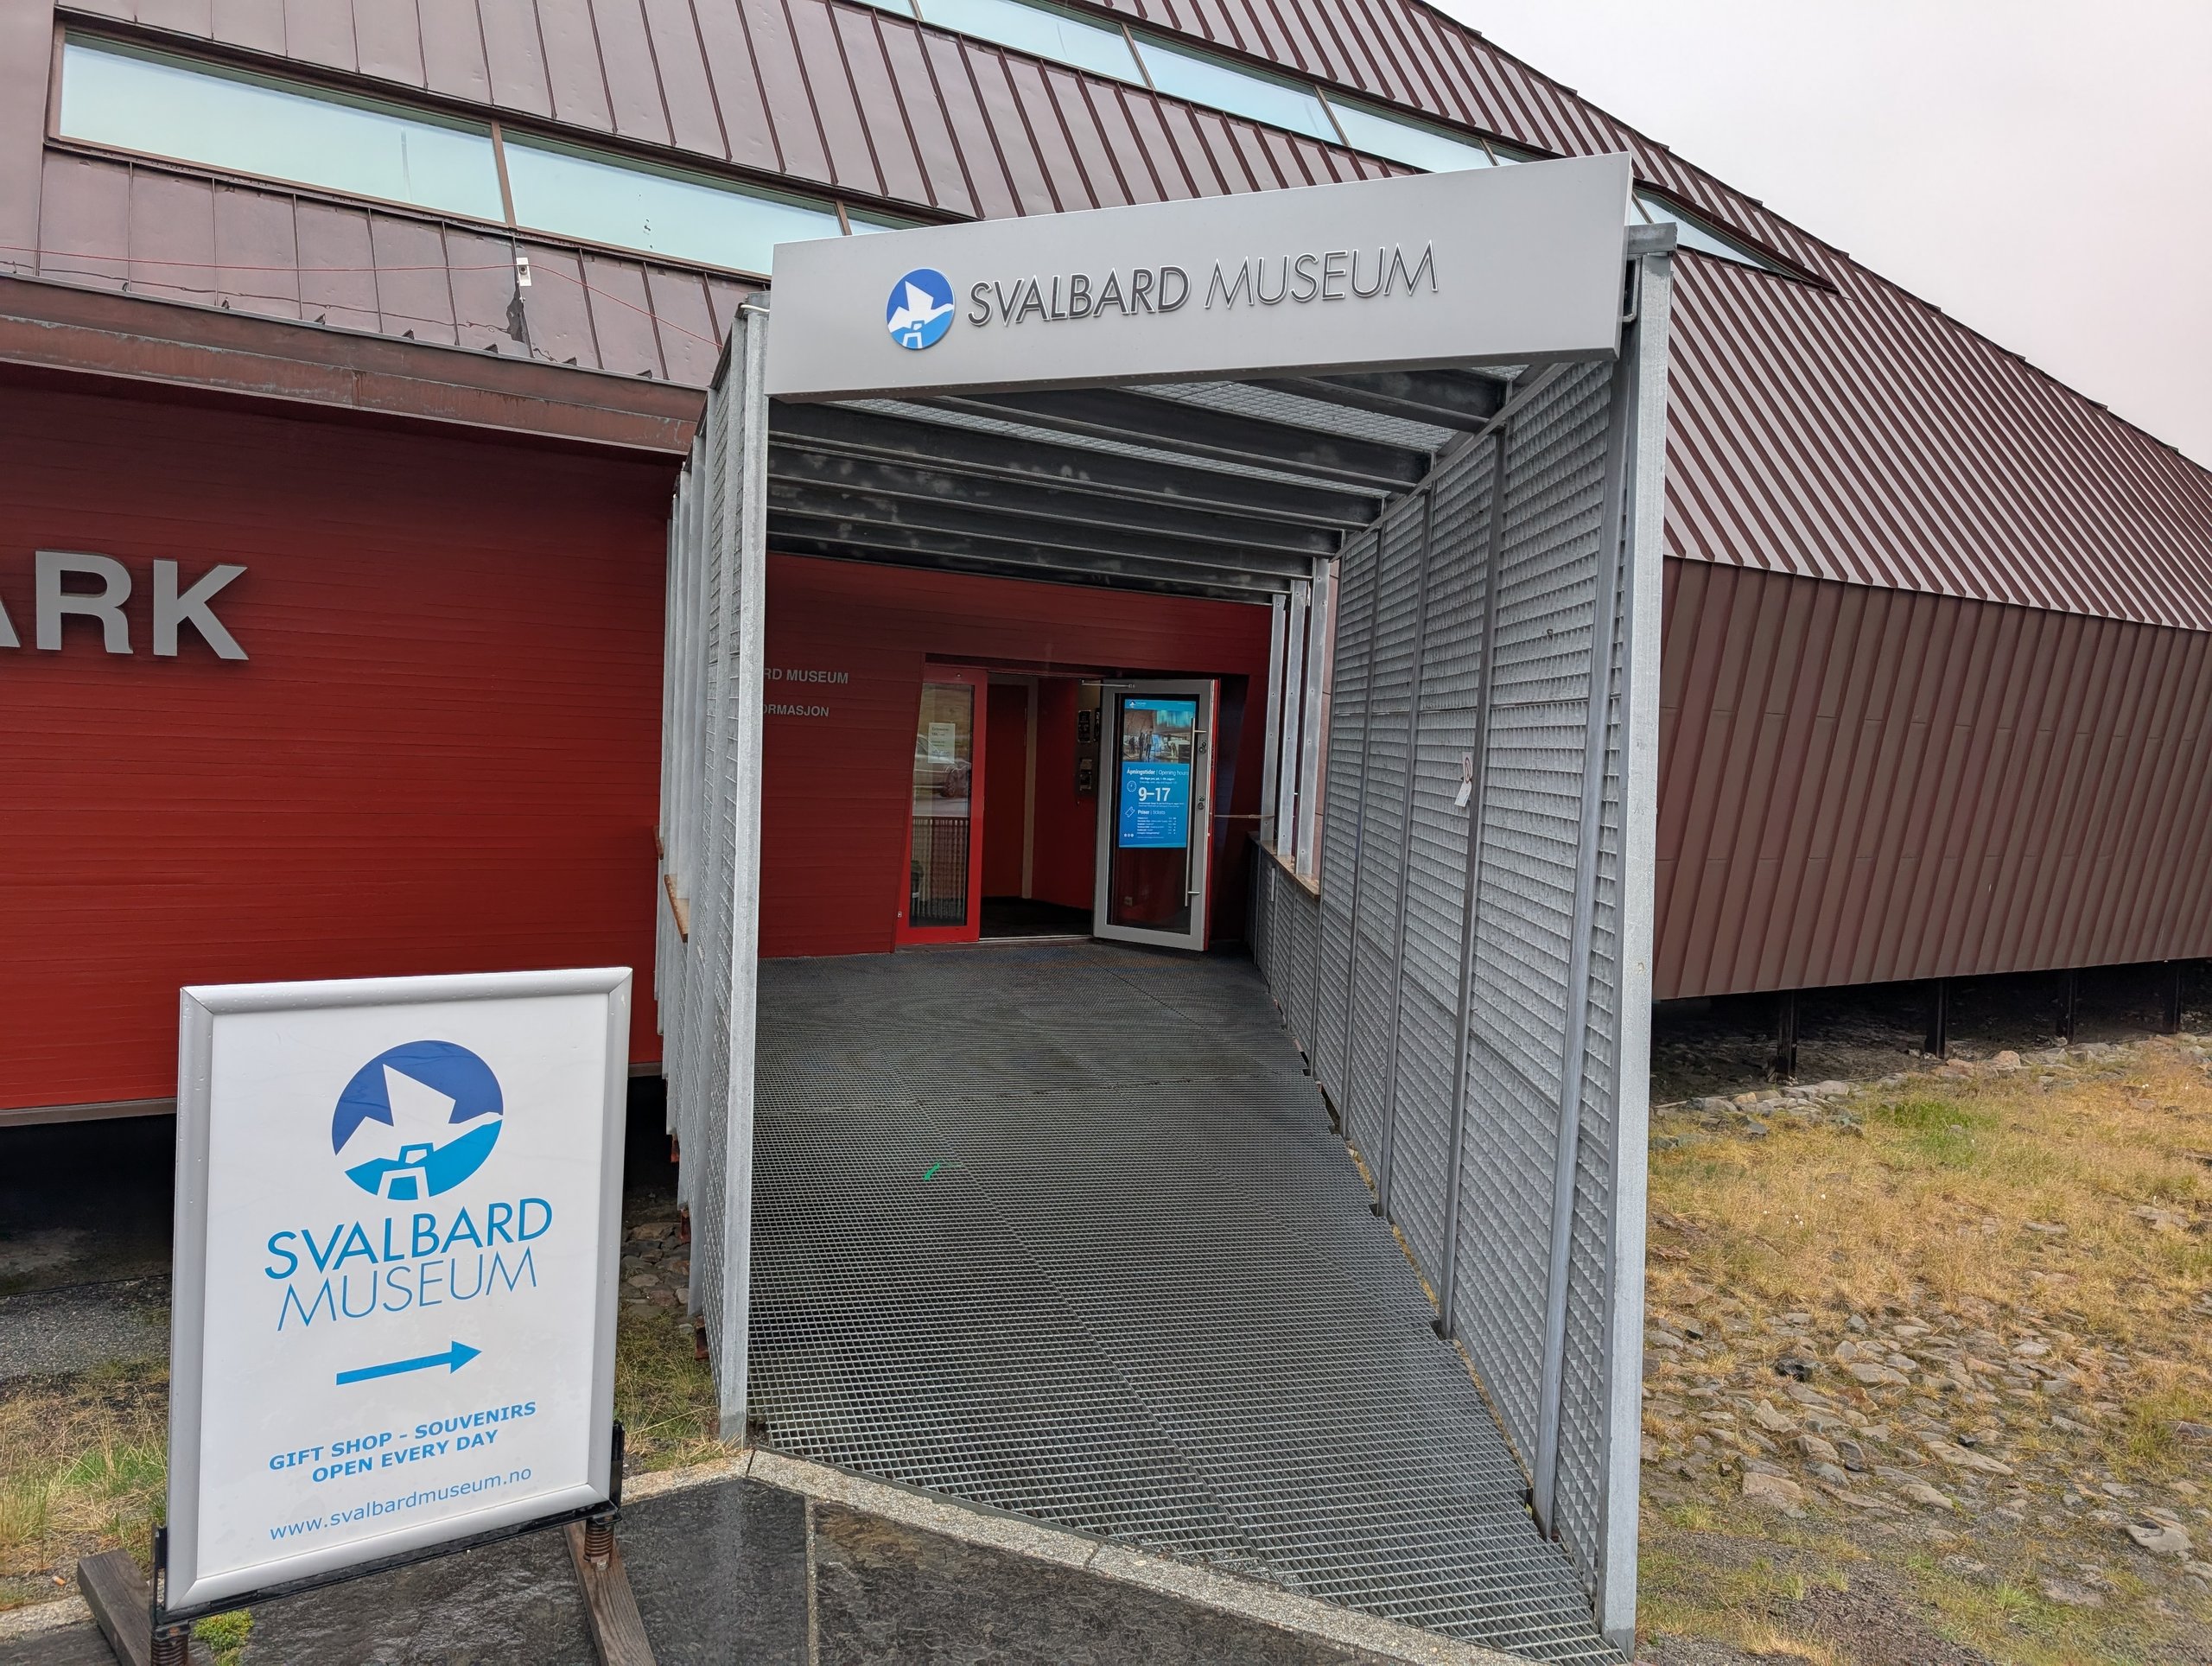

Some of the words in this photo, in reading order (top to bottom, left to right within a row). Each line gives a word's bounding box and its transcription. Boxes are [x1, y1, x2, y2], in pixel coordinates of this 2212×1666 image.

[967, 265, 1192, 327] SVALBARD
[1204, 239, 1439, 308] MUSEUM
[0, 550, 249, 660] RK
[786, 669, 849, 684] MUSEUM
[264, 1198, 553, 1280] SVALBARD
[276, 1247, 538, 1332] MUSEUM
[269, 1446, 324, 1471] GIFT
[331, 1431, 392, 1458] SHOP
[415, 1402, 537, 1439] SOUVENIRS
[312, 1457, 373, 1483] OPEN
[381, 1440, 449, 1468] EVERY
[456, 1429, 499, 1452] DAY
[270, 1467, 532, 1540] www.svalbardmuseum.no
